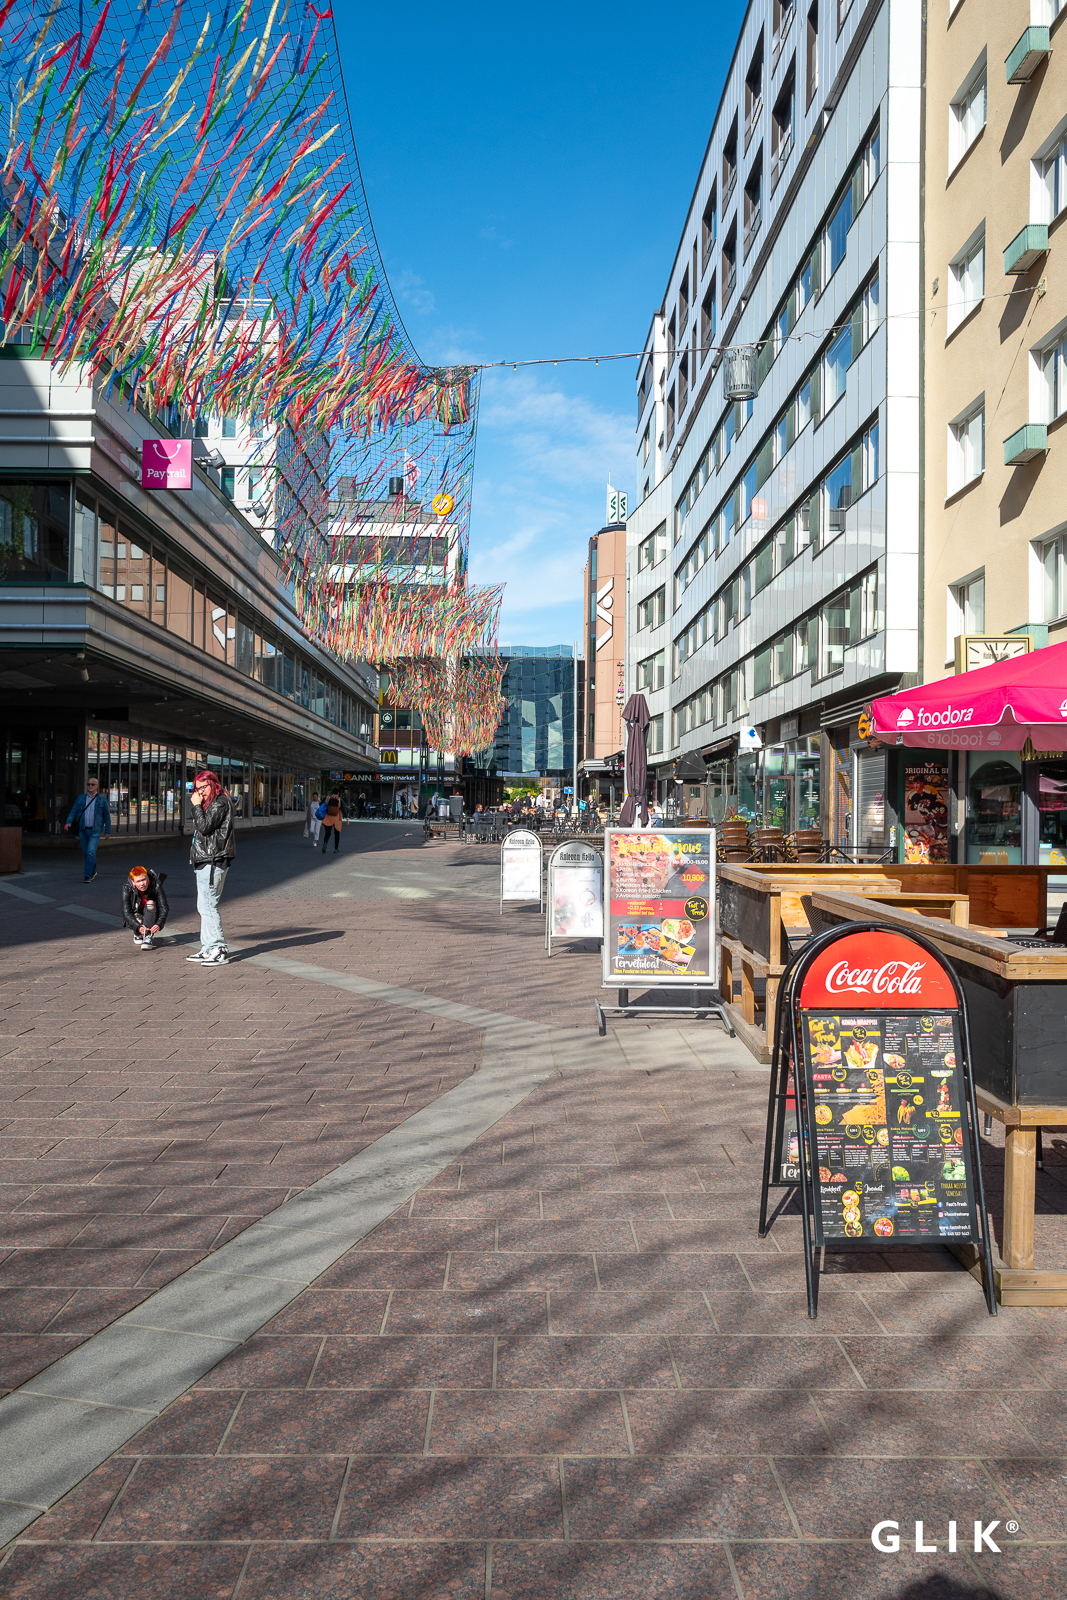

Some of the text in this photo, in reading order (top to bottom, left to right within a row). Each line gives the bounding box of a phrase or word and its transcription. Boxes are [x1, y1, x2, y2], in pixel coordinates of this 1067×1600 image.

[147, 468, 186, 480] Paytrail
[917, 705, 974, 727] foodora
[616, 837, 701, 859] Lounastarjous
[682, 874, 705, 882] 10,90€
[611, 955, 659, 969] Tervetuloa!
[825, 961, 927, 994] Coca-Cola
